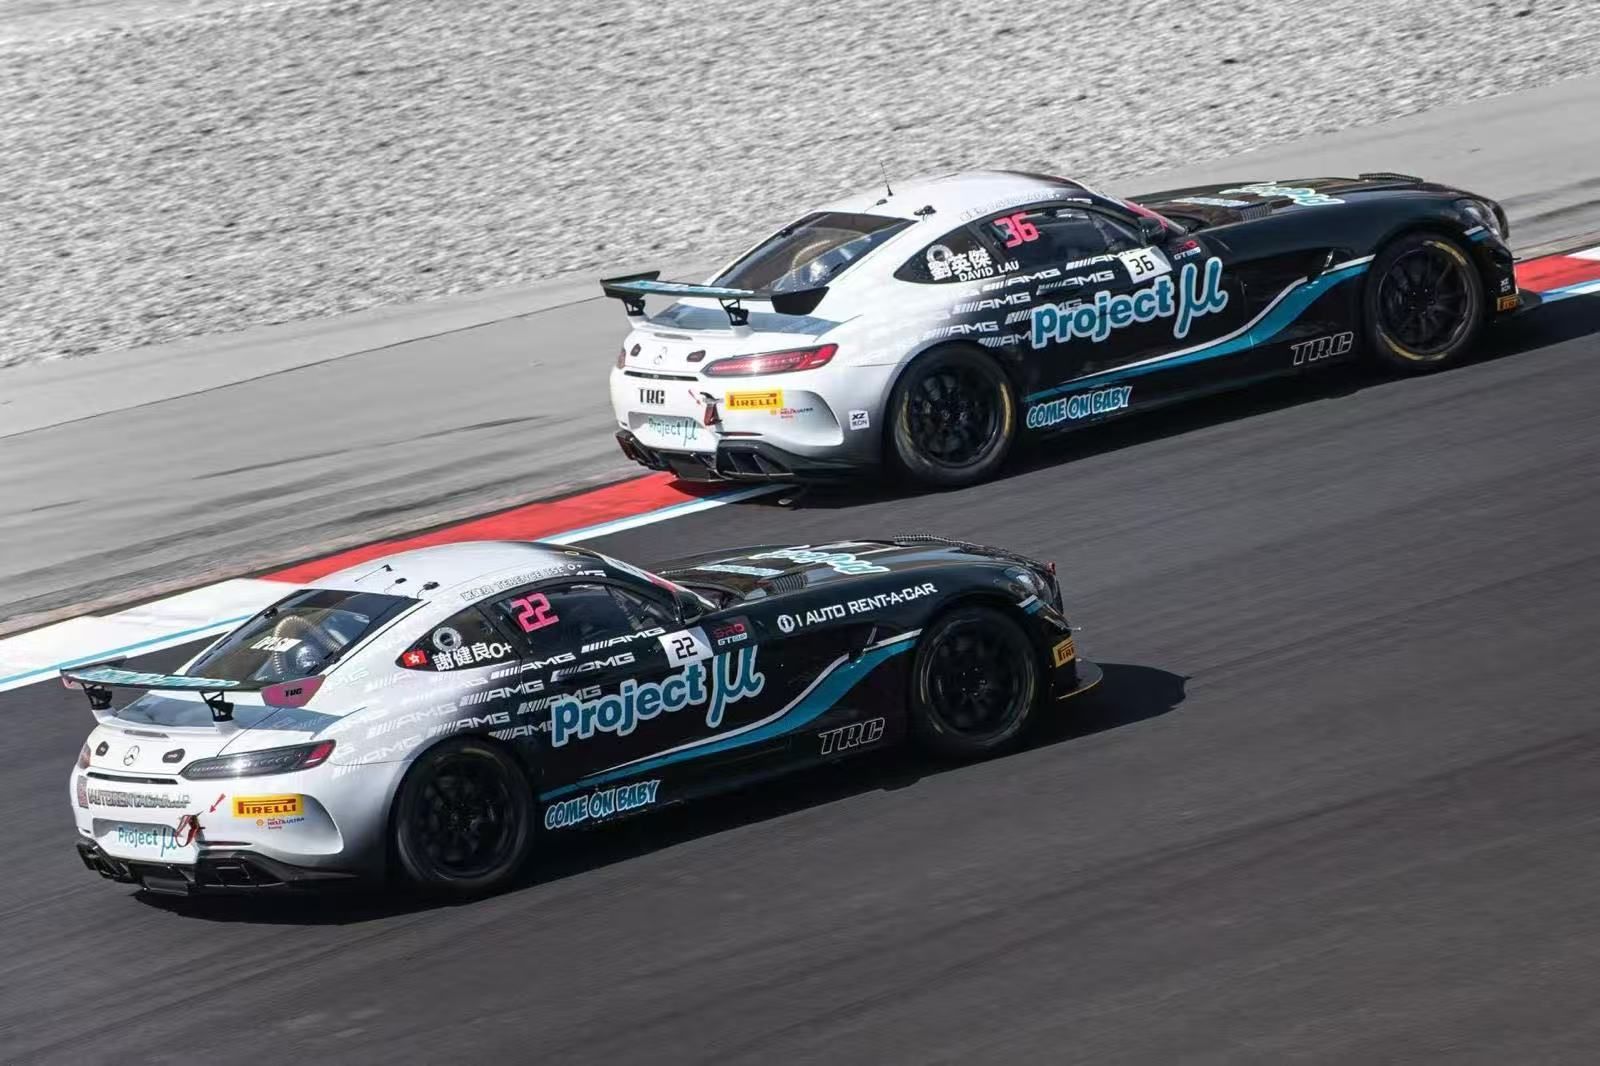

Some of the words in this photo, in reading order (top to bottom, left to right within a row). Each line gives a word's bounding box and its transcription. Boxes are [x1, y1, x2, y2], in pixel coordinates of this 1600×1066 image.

[994, 212, 1039, 248] 36
[959, 267, 994, 282] DAVID
[997, 260, 1020, 274] LAU
[1129, 255, 1154, 275] 36
[1007, 268, 1061, 286] AMG
[1062, 270, 1115, 286] AMG
[978, 292, 1032, 312] AMG
[949, 321, 999, 336] AMG
[729, 393, 777, 407] PIRELLI
[1026, 398, 1067, 429] COME
[1067, 393, 1091, 419] ON
[1092, 386, 1133, 414] BABY
[649, 417, 681, 437] Project
[511, 593, 559, 632] 22
[805, 604, 845, 625] AUTO
[847, 582, 938, 614] RENT-A-CAR
[607, 627, 666, 647] AMG
[672, 636, 698, 660] 22
[520, 651, 577, 671] AMG
[578, 652, 636, 672] AMG
[489, 680, 544, 699] AMG
[455, 712, 511, 733] AMG
[237, 798, 297, 814] PIRELLI
[545, 795, 589, 830] COME
[589, 789, 616, 818] ON
[616, 779, 660, 811] BABY
[118, 826, 159, 848] Project
